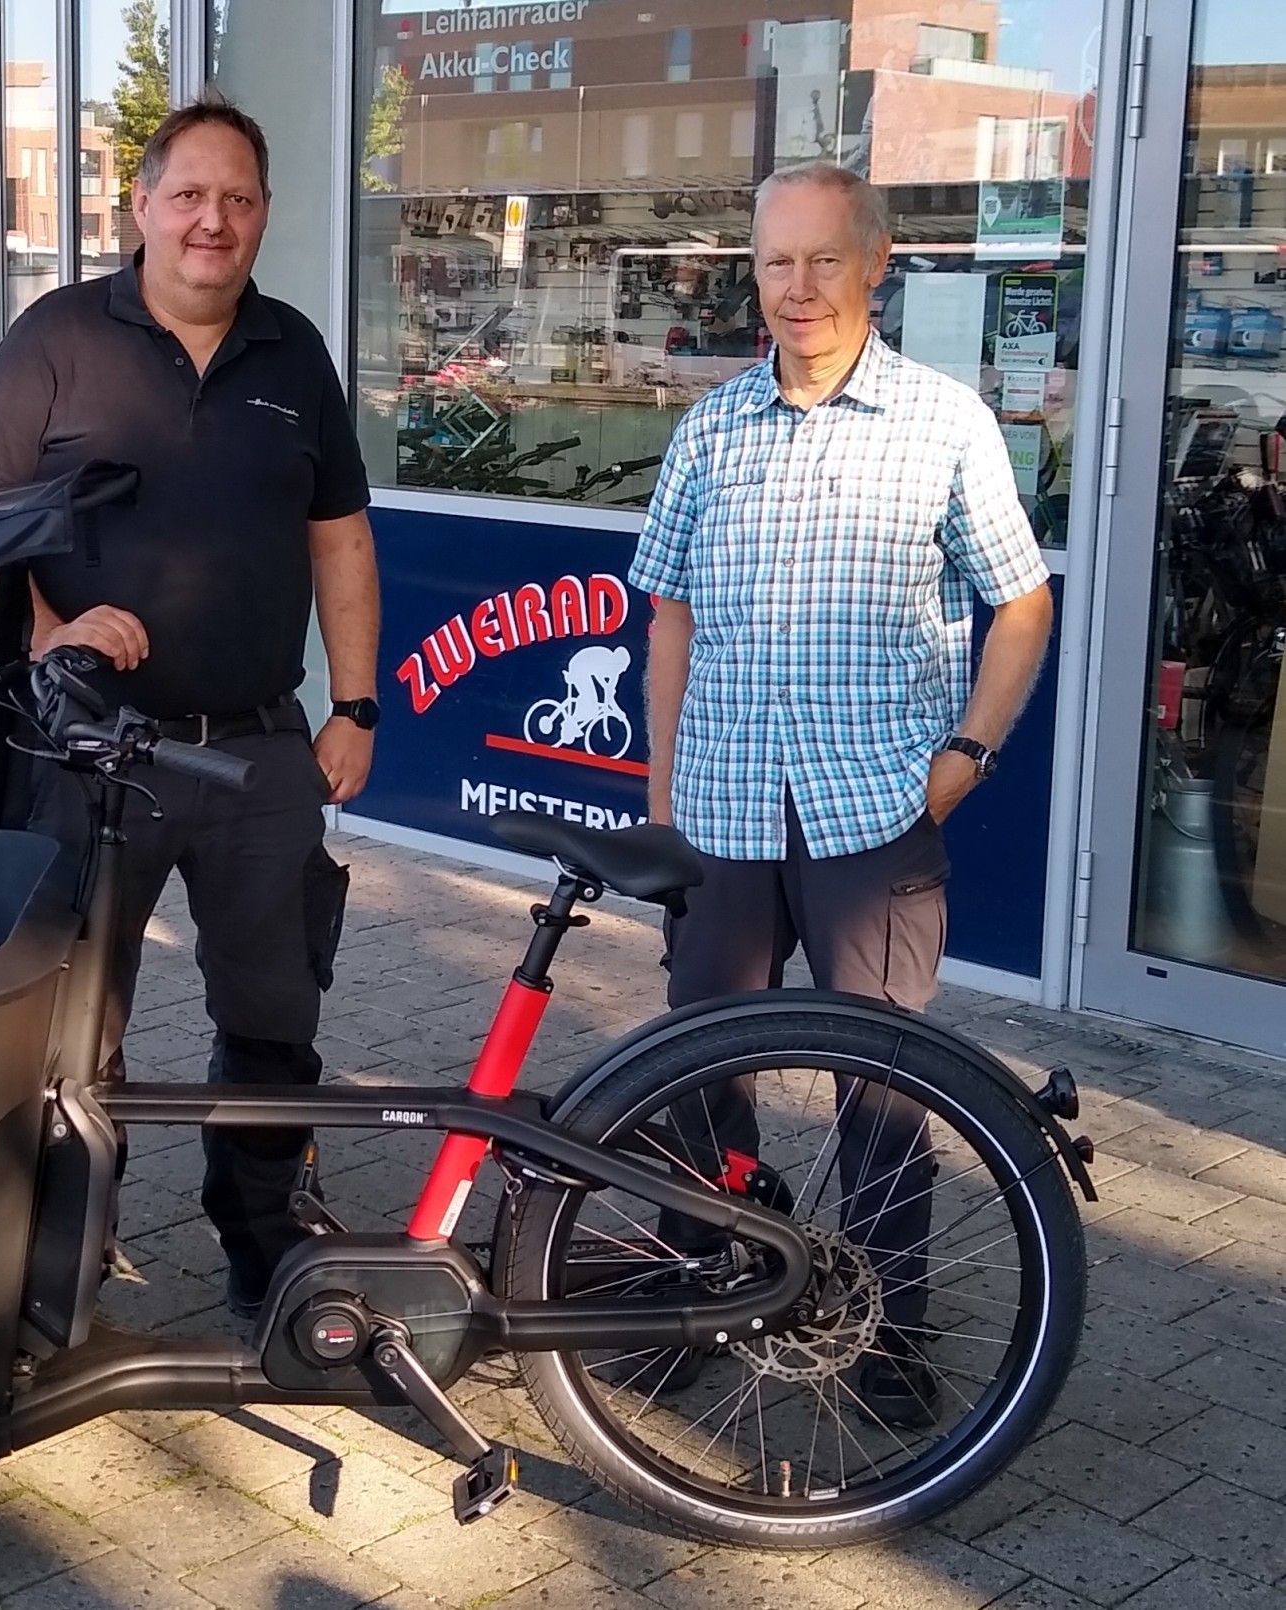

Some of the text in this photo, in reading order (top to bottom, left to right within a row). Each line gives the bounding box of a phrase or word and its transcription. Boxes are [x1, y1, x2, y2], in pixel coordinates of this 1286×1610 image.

[419, 41, 570, 80] Akku-Check
[1001, 342, 1020, 350] AXA
[396, 573, 629, 715] ZWEIRAD
[381, 1110, 424, 1124] CARQON
